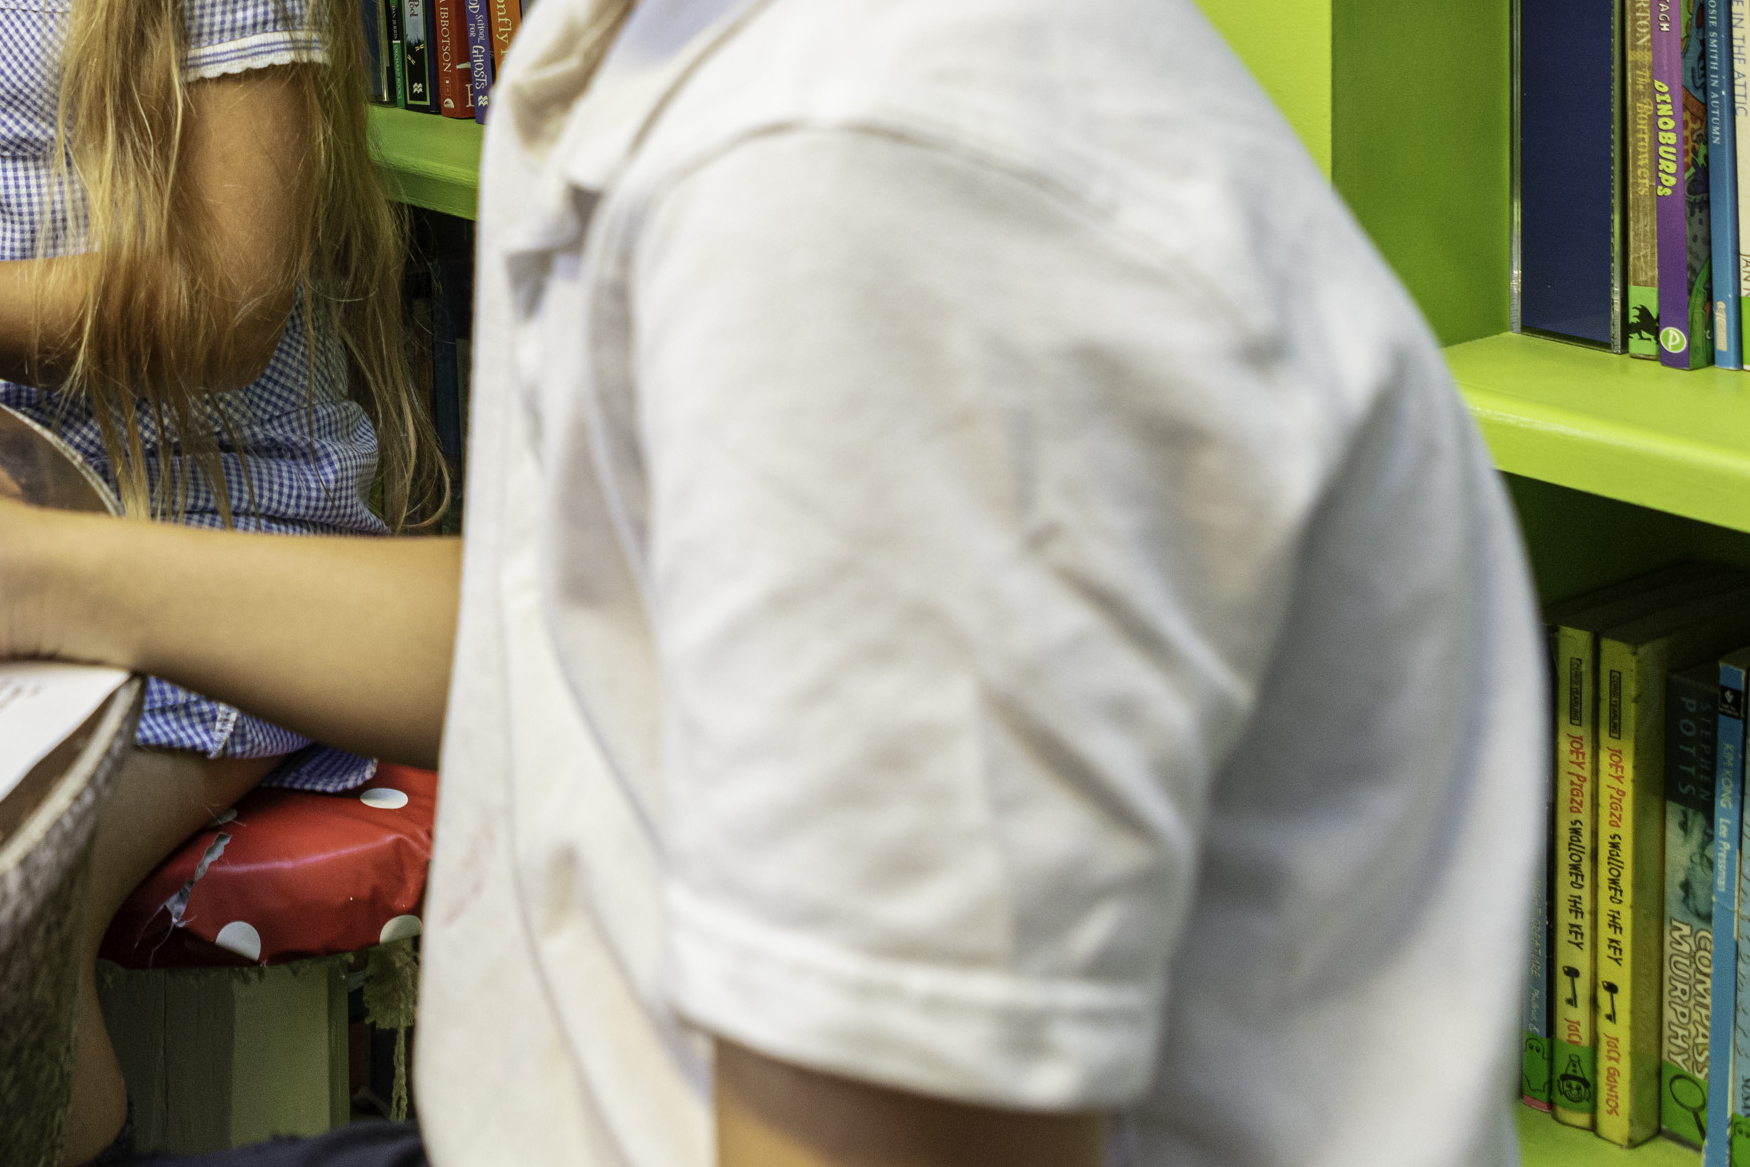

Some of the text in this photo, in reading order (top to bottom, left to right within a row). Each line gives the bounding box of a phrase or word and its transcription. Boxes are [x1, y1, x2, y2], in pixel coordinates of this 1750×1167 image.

[438, 7, 451, 73] IBBOTSON
[474, 14, 485, 43] SCHOOL
[1709, 30, 1719, 69] SMITH
[1732, 11, 1746, 30] IN
[1733, 34, 1747, 65] THE
[472, 43, 487, 90] GHOSTS
[1710, 74, 1720, 86] IN
[1734, 72, 1748, 117] ATTIC
[1636, 99, 1654, 195] Borrowers
[1653, 79, 1678, 196] DINOBURPS
[1711, 91, 1721, 144] AUTUMN
[1678, 697, 1696, 794] POTTS
[1567, 734, 1585, 951] JOEY THE KEY
[1606, 747, 1624, 966] JOEY THE KEY
[1669, 918, 1691, 1072] MURPHY
[1692, 928, 1712, 1081] COMPASS
